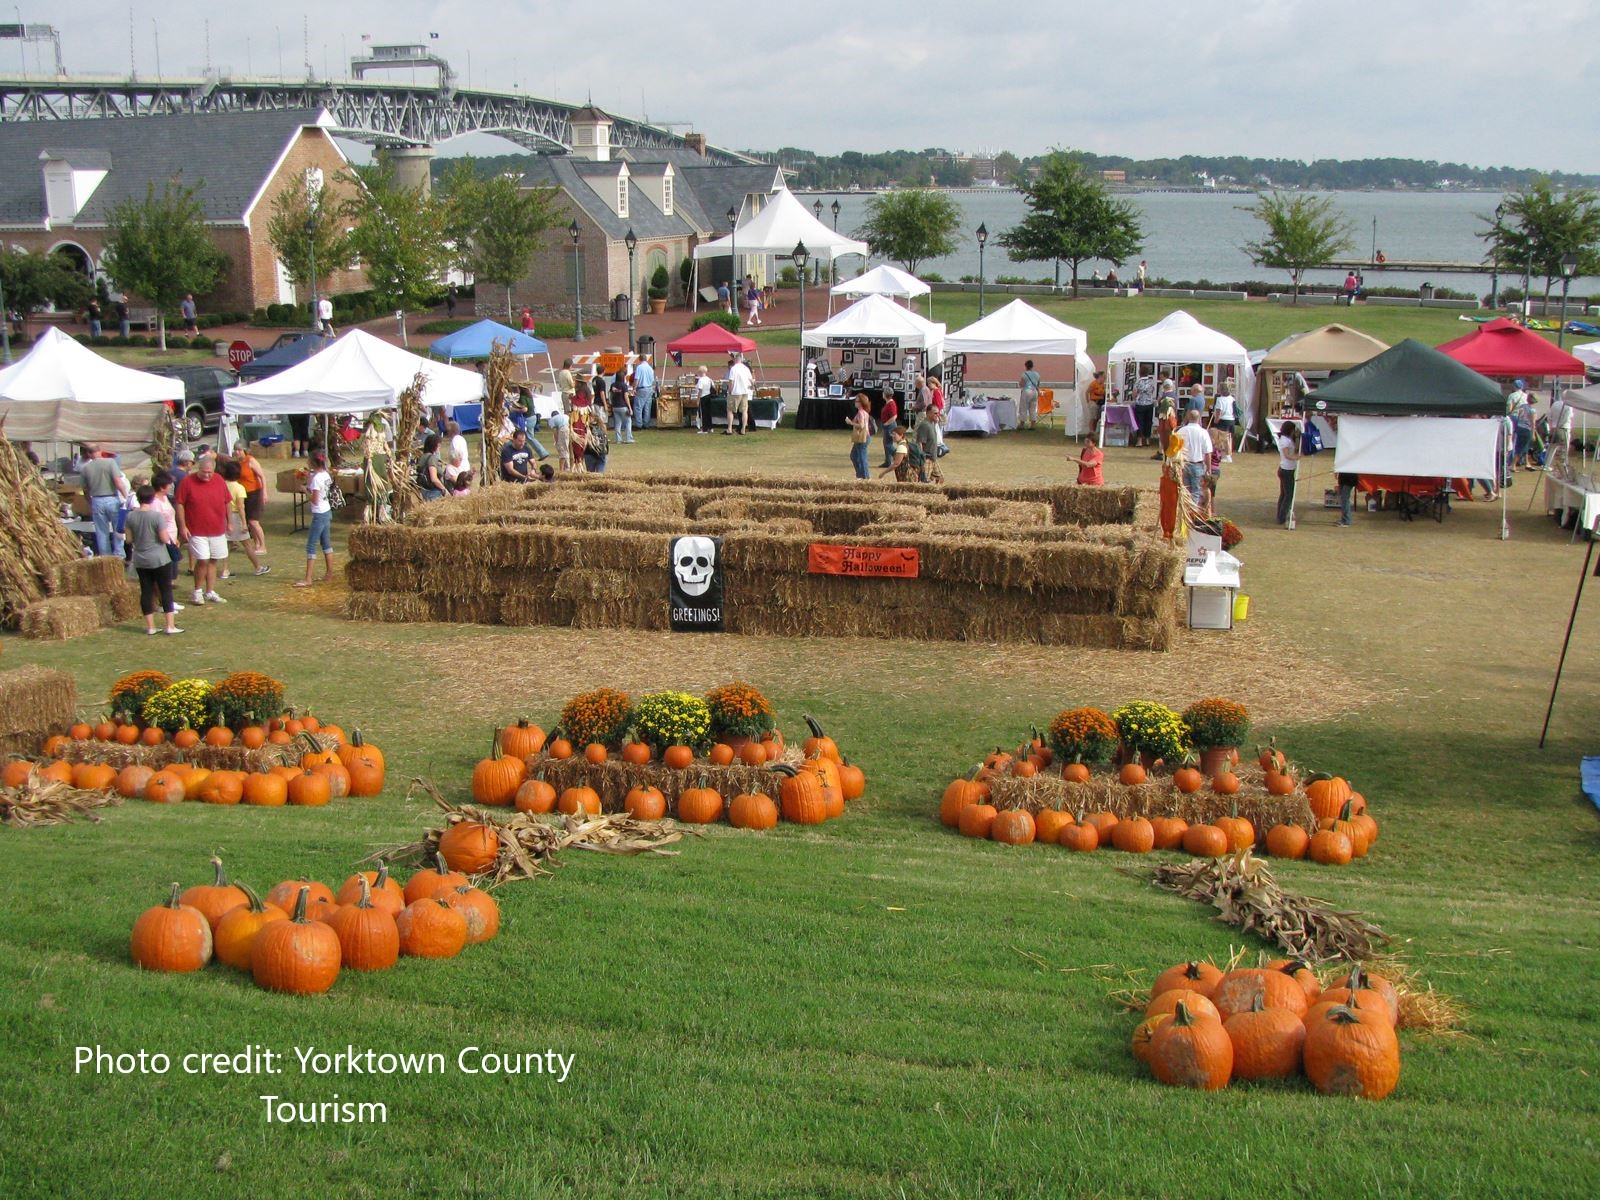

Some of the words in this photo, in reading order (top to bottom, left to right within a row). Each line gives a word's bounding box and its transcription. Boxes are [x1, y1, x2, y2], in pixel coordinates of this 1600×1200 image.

[847, 338, 856, 348] My
[869, 337, 898, 348] Photography
[229, 350, 252, 362] STOP
[843, 547, 882, 561] Happy
[841, 560, 906, 574] Halloween!
[673, 607, 721, 622] GREETINGS!
